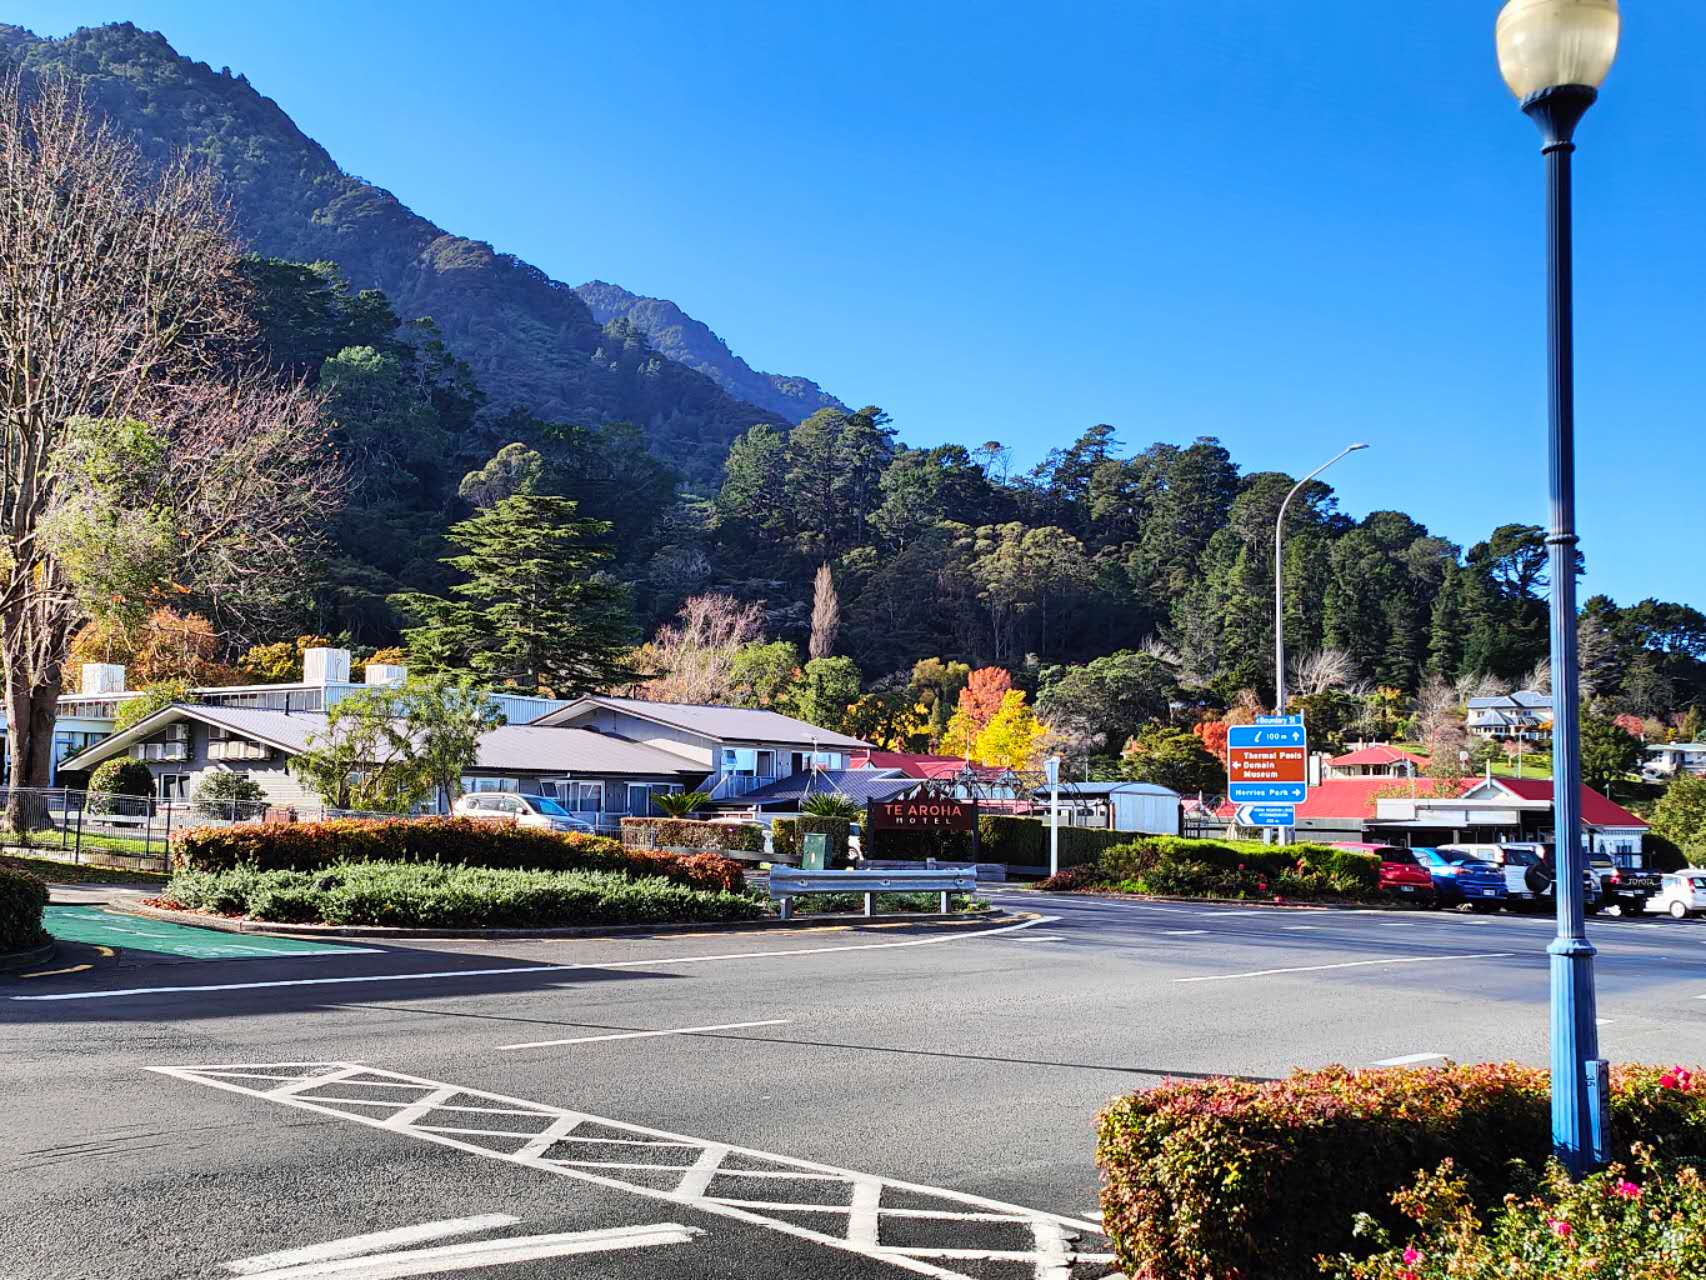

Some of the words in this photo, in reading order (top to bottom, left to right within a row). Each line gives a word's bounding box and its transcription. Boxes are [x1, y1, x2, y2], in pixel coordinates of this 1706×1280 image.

[1259, 716, 1287, 725] Boundary
[1266, 732, 1280, 740] 100
[1244, 761, 1275, 769] Domain
[1244, 770, 1278, 778] Museum
[885, 805, 903, 816] TE
[907, 805, 962, 816] AROHA
